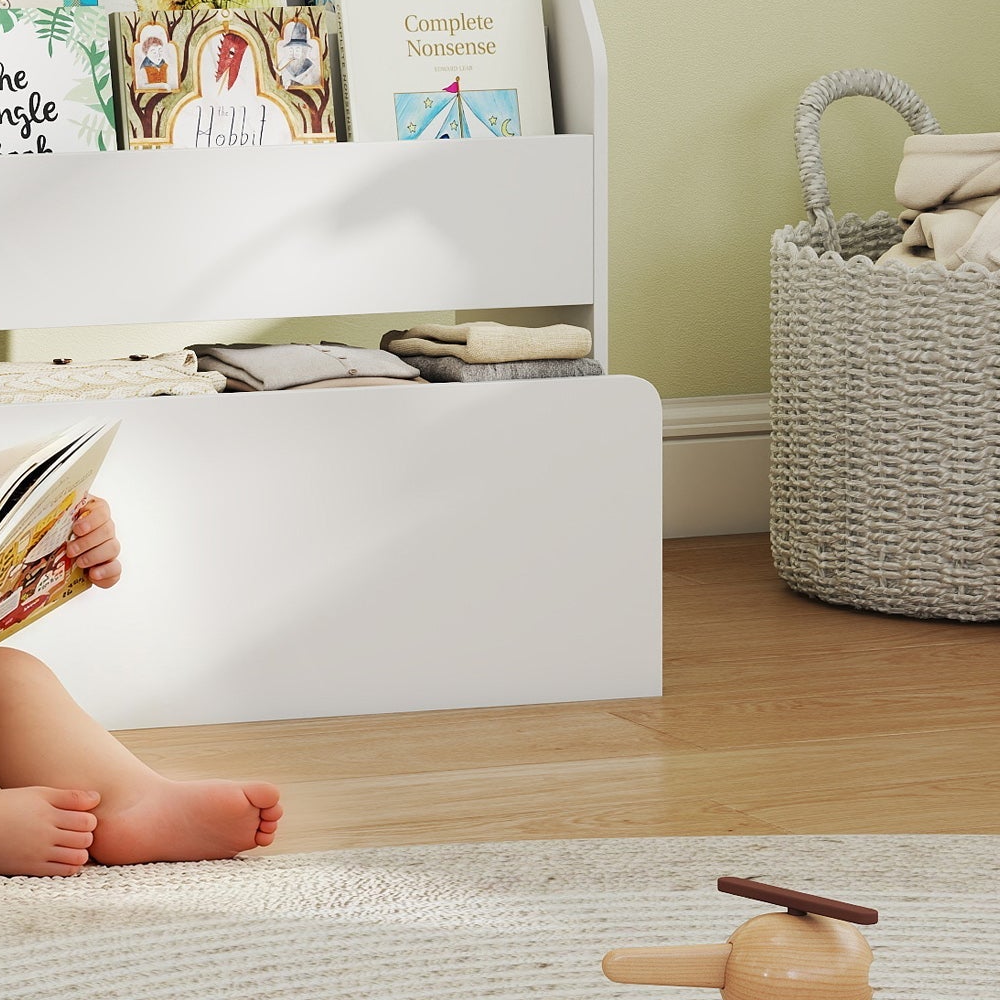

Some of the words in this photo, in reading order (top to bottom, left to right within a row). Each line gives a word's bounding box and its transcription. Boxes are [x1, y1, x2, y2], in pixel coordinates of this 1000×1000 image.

[405, 12, 494, 36] Complete
[407, 40, 496, 57] Nonsense
[196, 105, 267, 148] Hobbit
